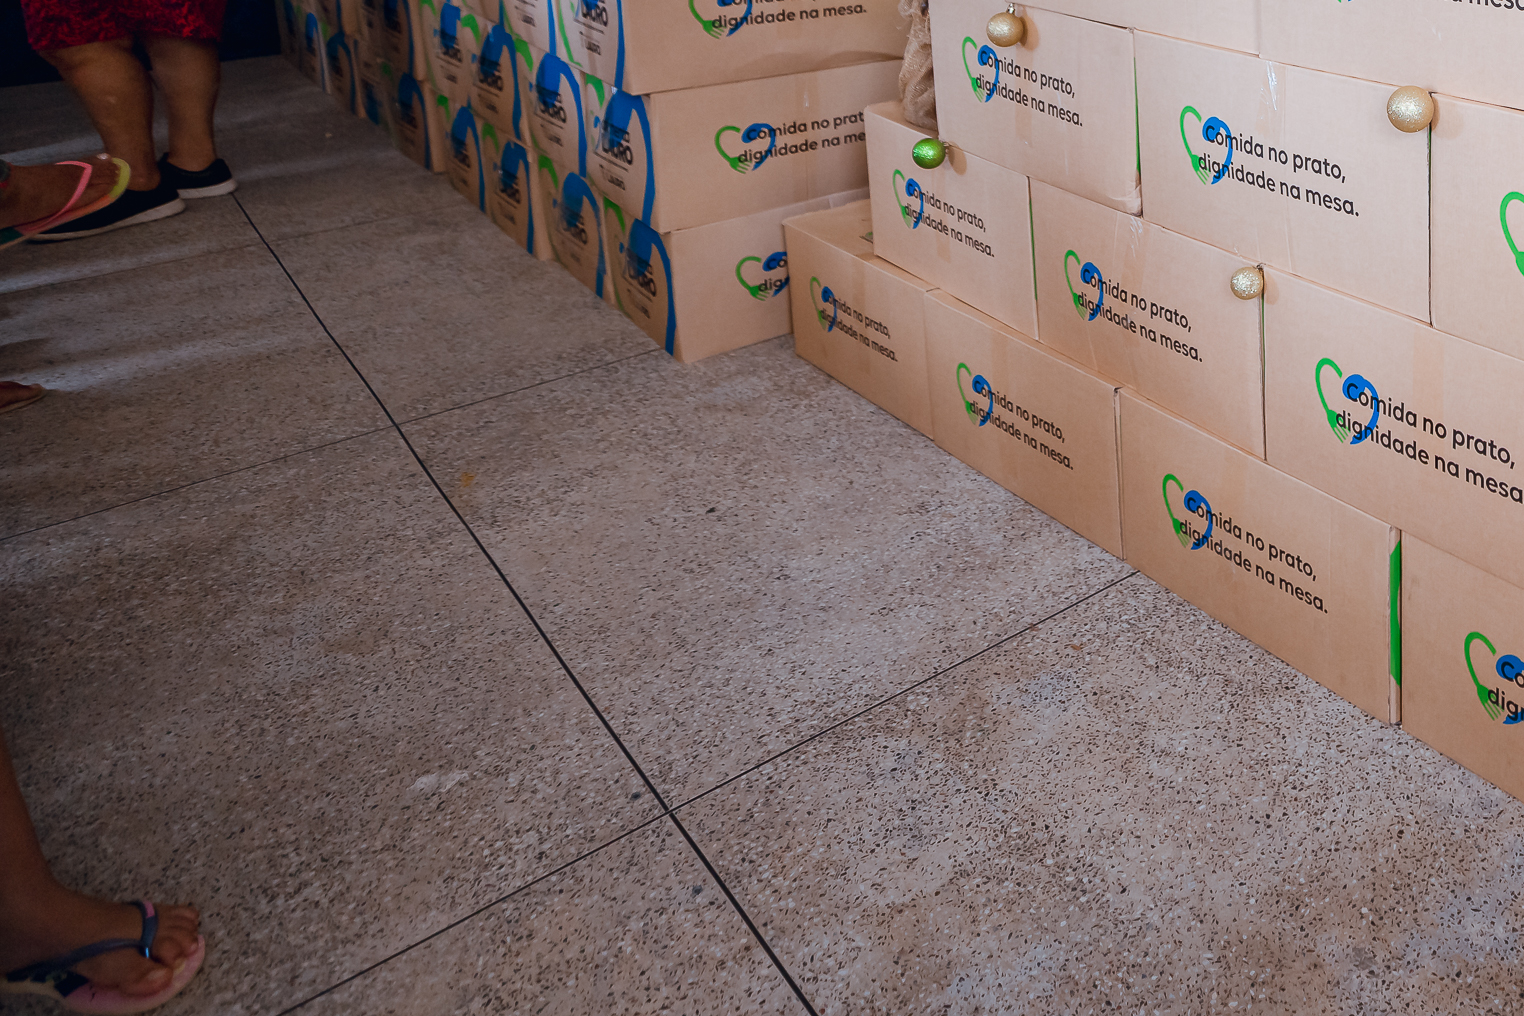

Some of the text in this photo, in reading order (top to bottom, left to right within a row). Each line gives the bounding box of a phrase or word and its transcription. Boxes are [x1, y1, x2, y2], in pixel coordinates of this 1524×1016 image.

[712, 3, 867, 30] dignidade na mesa.
[976, 74, 1082, 126] dignidade na mesa.
[981, 51, 1075, 98] Comida no prato,
[738, 139, 817, 164] dignidade
[822, 136, 840, 148] na
[747, 121, 807, 140] Comida
[812, 119, 829, 130] no
[1206, 125, 1346, 183] Comida no prato,
[908, 184, 986, 232] Comida no prato,
[1199, 153, 1359, 216] dignidade na mesa.
[904, 203, 994, 257] dignidade na mesa.
[1078, 292, 1202, 362] dignidade na mesa.
[1083, 269, 1191, 333] Comida no prato,
[970, 400, 1073, 470] dignidade na mesa.
[974, 381, 1065, 443] Comida no prato,
[1347, 383, 1515, 470] Comida no prato,
[1336, 410, 1429, 465] dignidade
[1435, 454, 1459, 478] na
[1180, 520, 1328, 613] dignidade na mesa.
[1187, 497, 1317, 582] Comida no prato,
